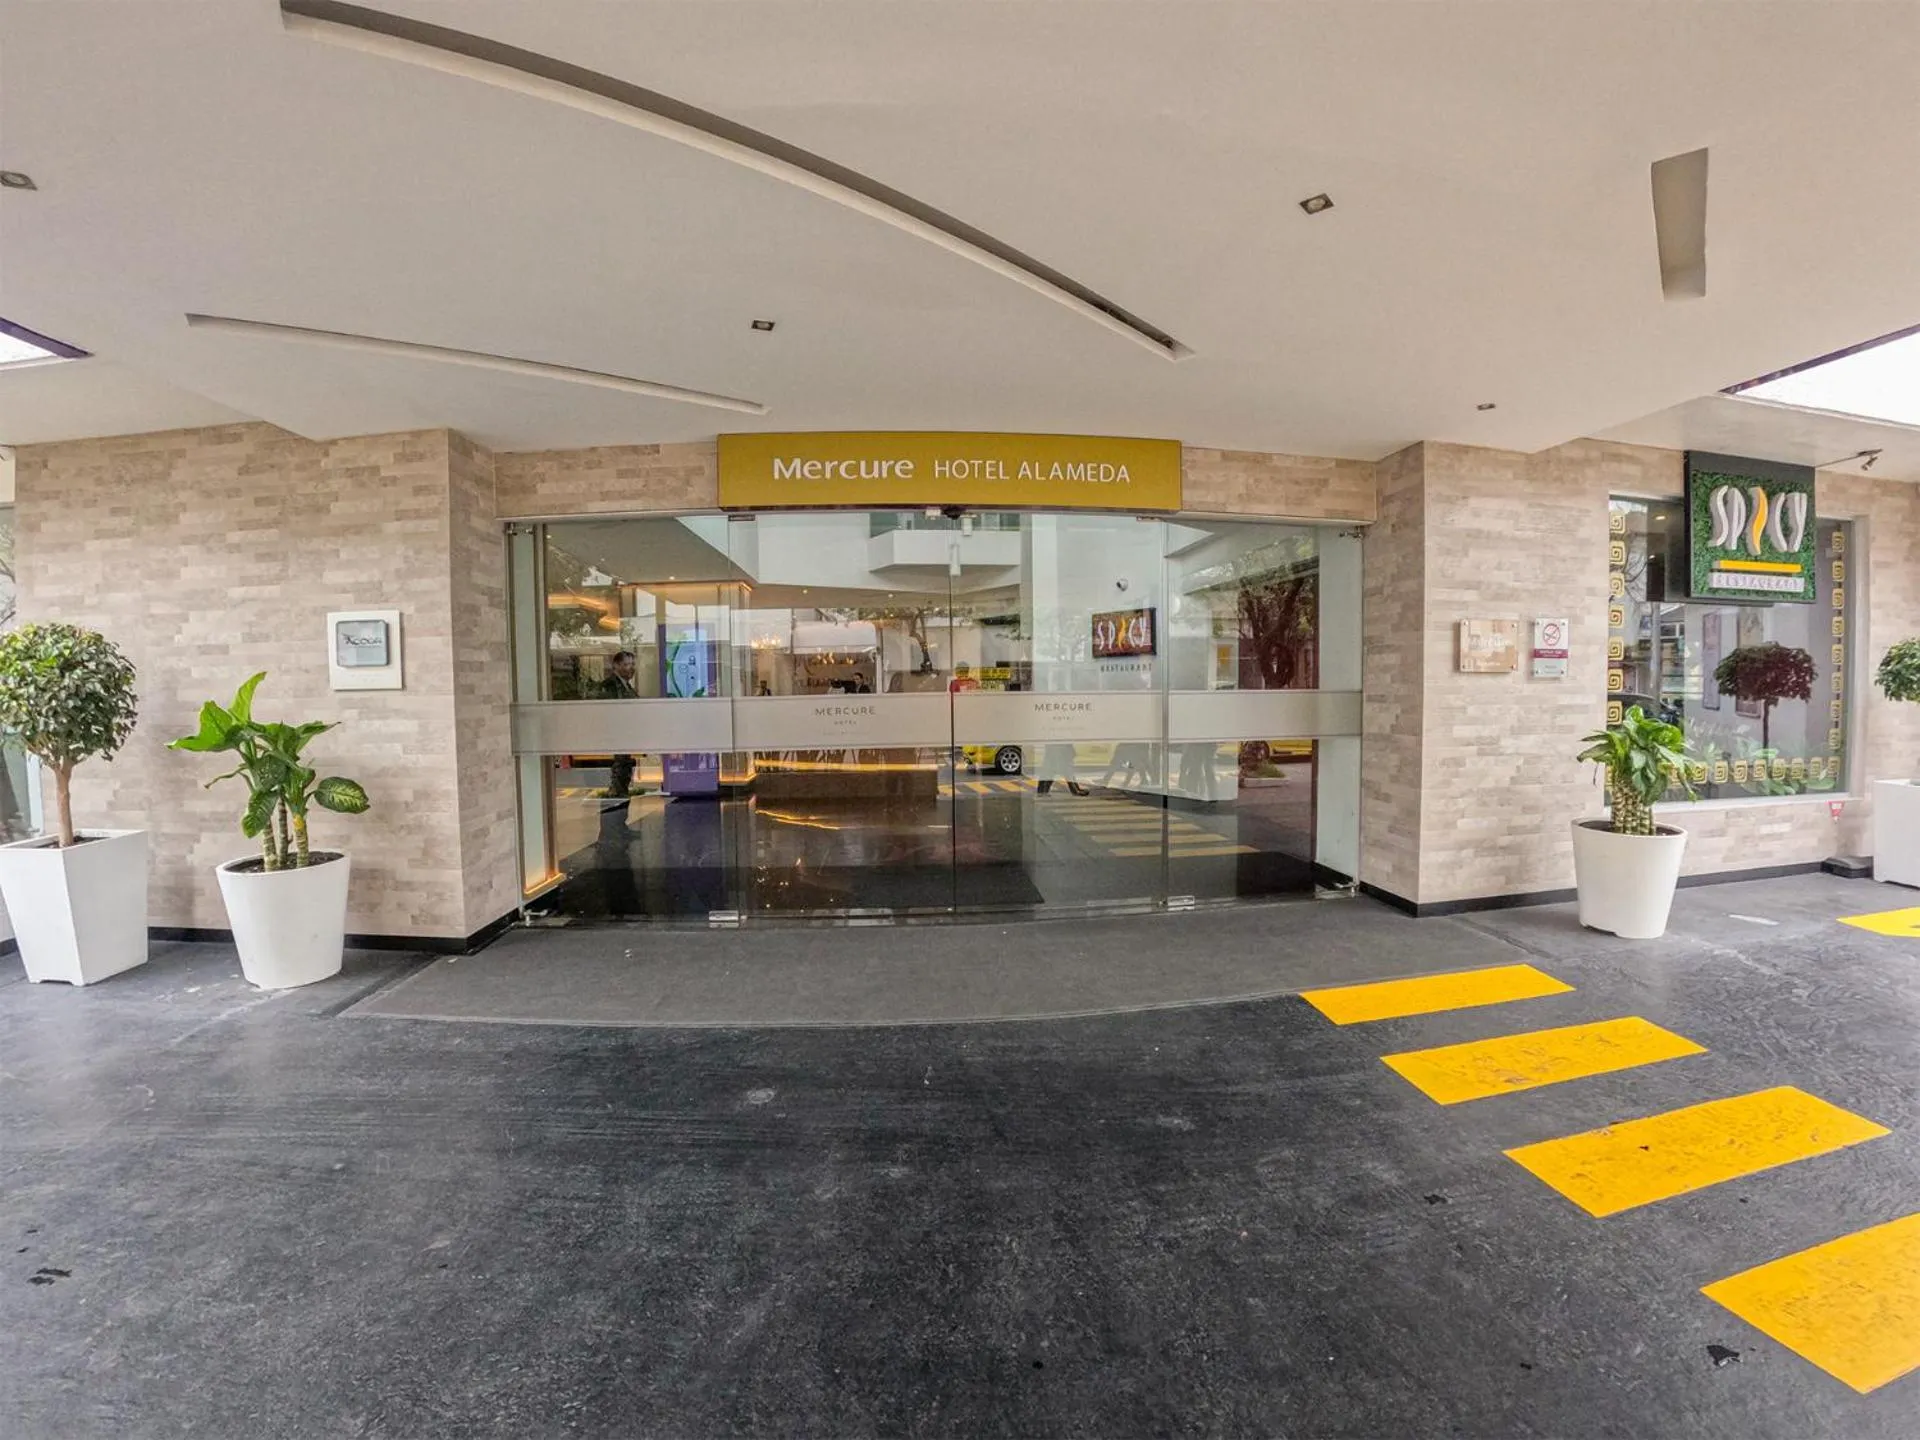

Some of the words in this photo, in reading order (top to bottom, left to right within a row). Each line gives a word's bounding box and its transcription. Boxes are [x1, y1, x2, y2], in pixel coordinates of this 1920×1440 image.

[773, 457, 914, 480] Mercure
[934, 459, 1010, 479] HOTEL
[1017, 461, 1130, 482] ALAMEDA
[1708, 485, 1808, 556] SPICY
[815, 706, 876, 716] MERCURE
[1034, 702, 1093, 712] MERCURE
